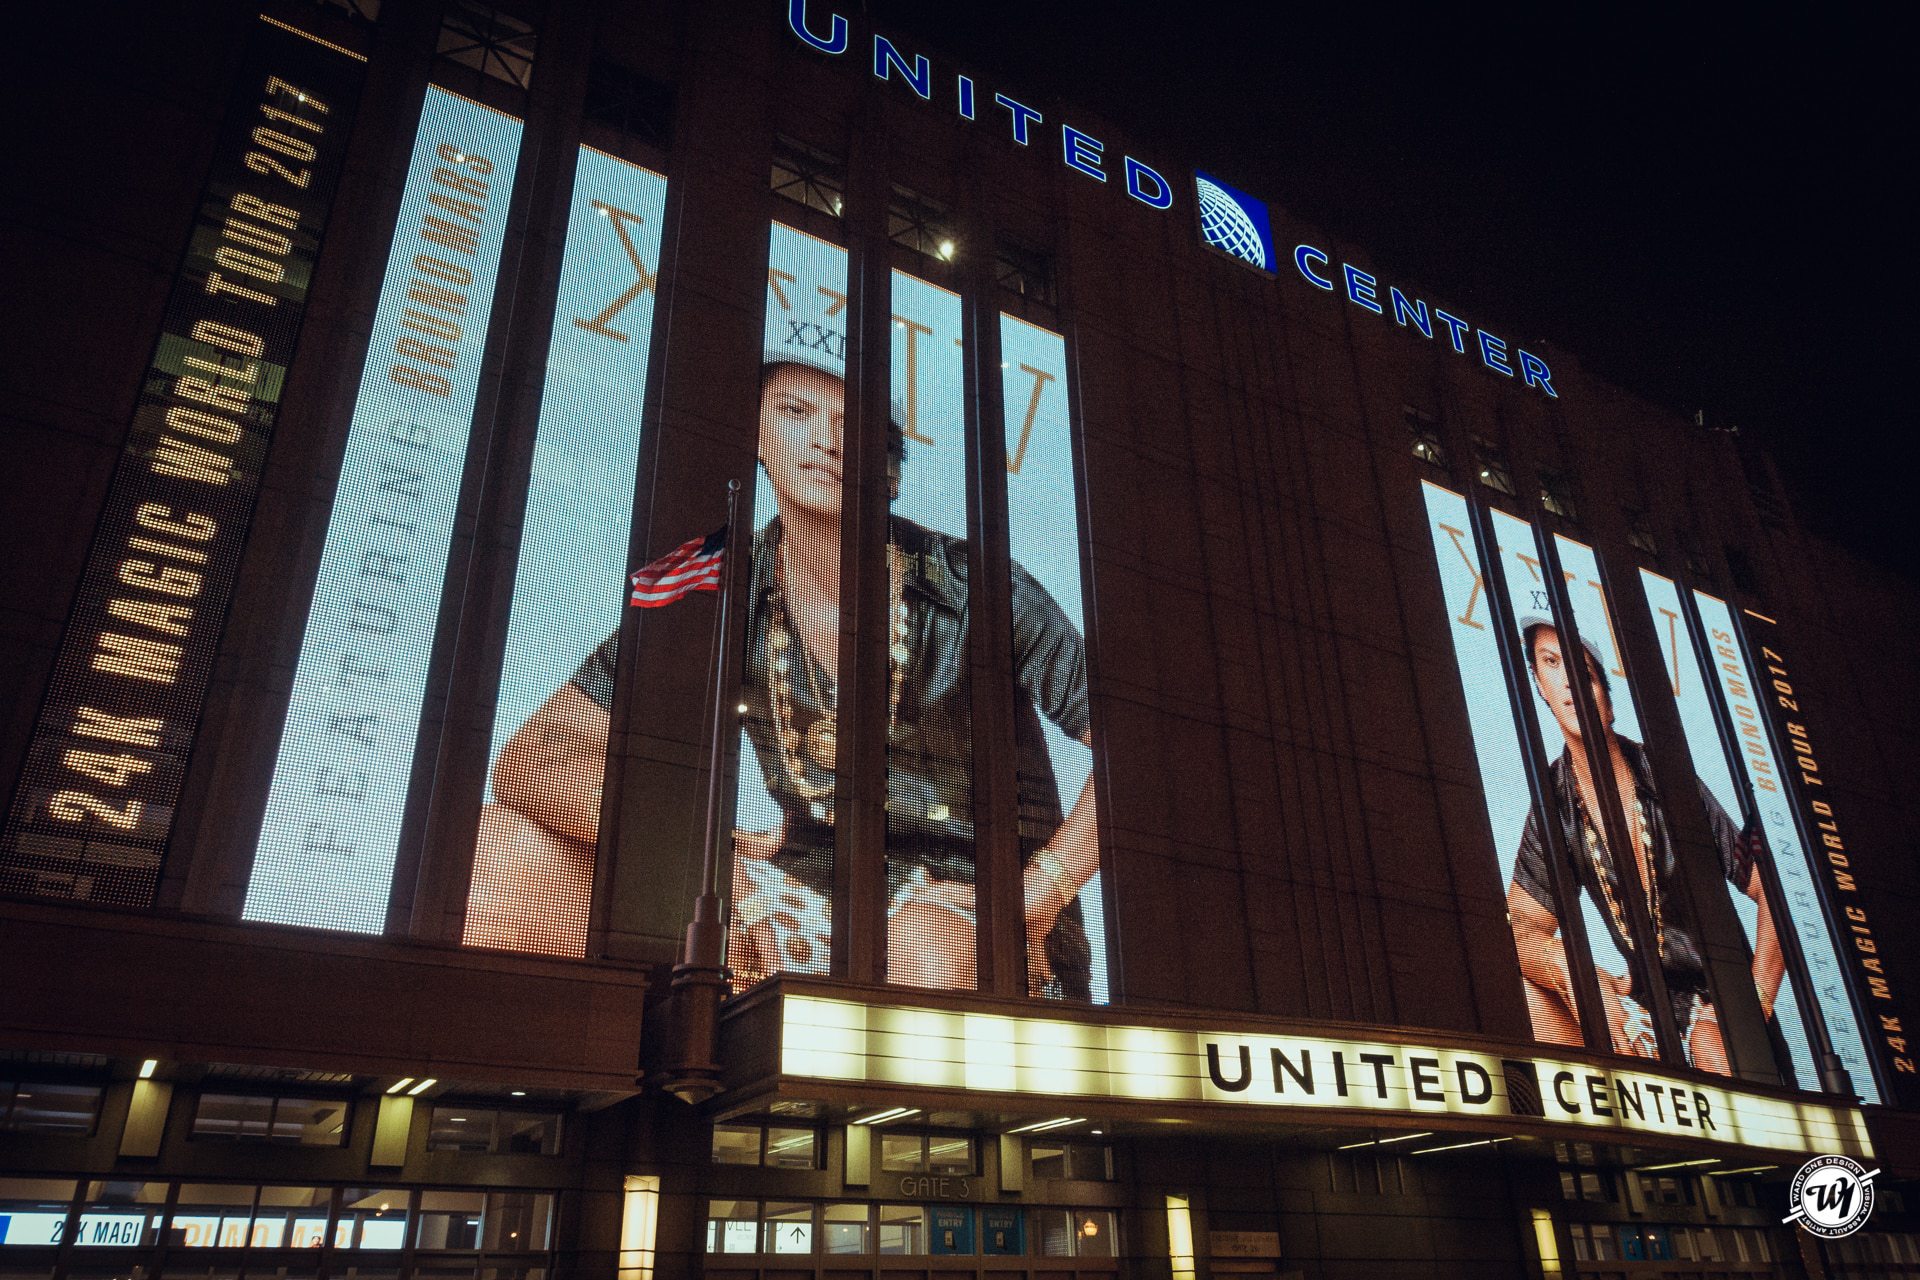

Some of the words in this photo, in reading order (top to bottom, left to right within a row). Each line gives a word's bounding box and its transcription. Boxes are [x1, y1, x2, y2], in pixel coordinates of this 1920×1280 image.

[244, 75, 329, 188] 2017
[205, 192, 301, 306] TOUR
[420, 144, 493, 256] MARS
[788, 0, 1172, 209] UNITED
[1294, 244, 1558, 397] CENTER
[389, 255, 473, 398] BRUNO
[151, 319, 265, 486] WORLD
[92, 502, 218, 683] MAGIC
[303, 417, 434, 857] FEATURING
[1712, 628, 1748, 699] MARS
[1762, 646, 1799, 712] 2017
[48, 707, 164, 830] 24K
[1734, 703, 1777, 793] BRUNO
[1787, 722, 1823, 786] TOUR
[1812, 800, 1857, 892] WORLD
[1768, 808, 1859, 1066] FEATURING
[1845, 905, 1892, 1000] MAGIC
[1206, 1043, 1494, 1105] UNITED
[1553, 1071, 1717, 1131] CENTER
[1878, 1014, 1918, 1074] 24K
[51, 1220, 87, 1243] 2K
[901, 1176, 950, 1197] GATE
[960, 1178, 970, 1198] 3
